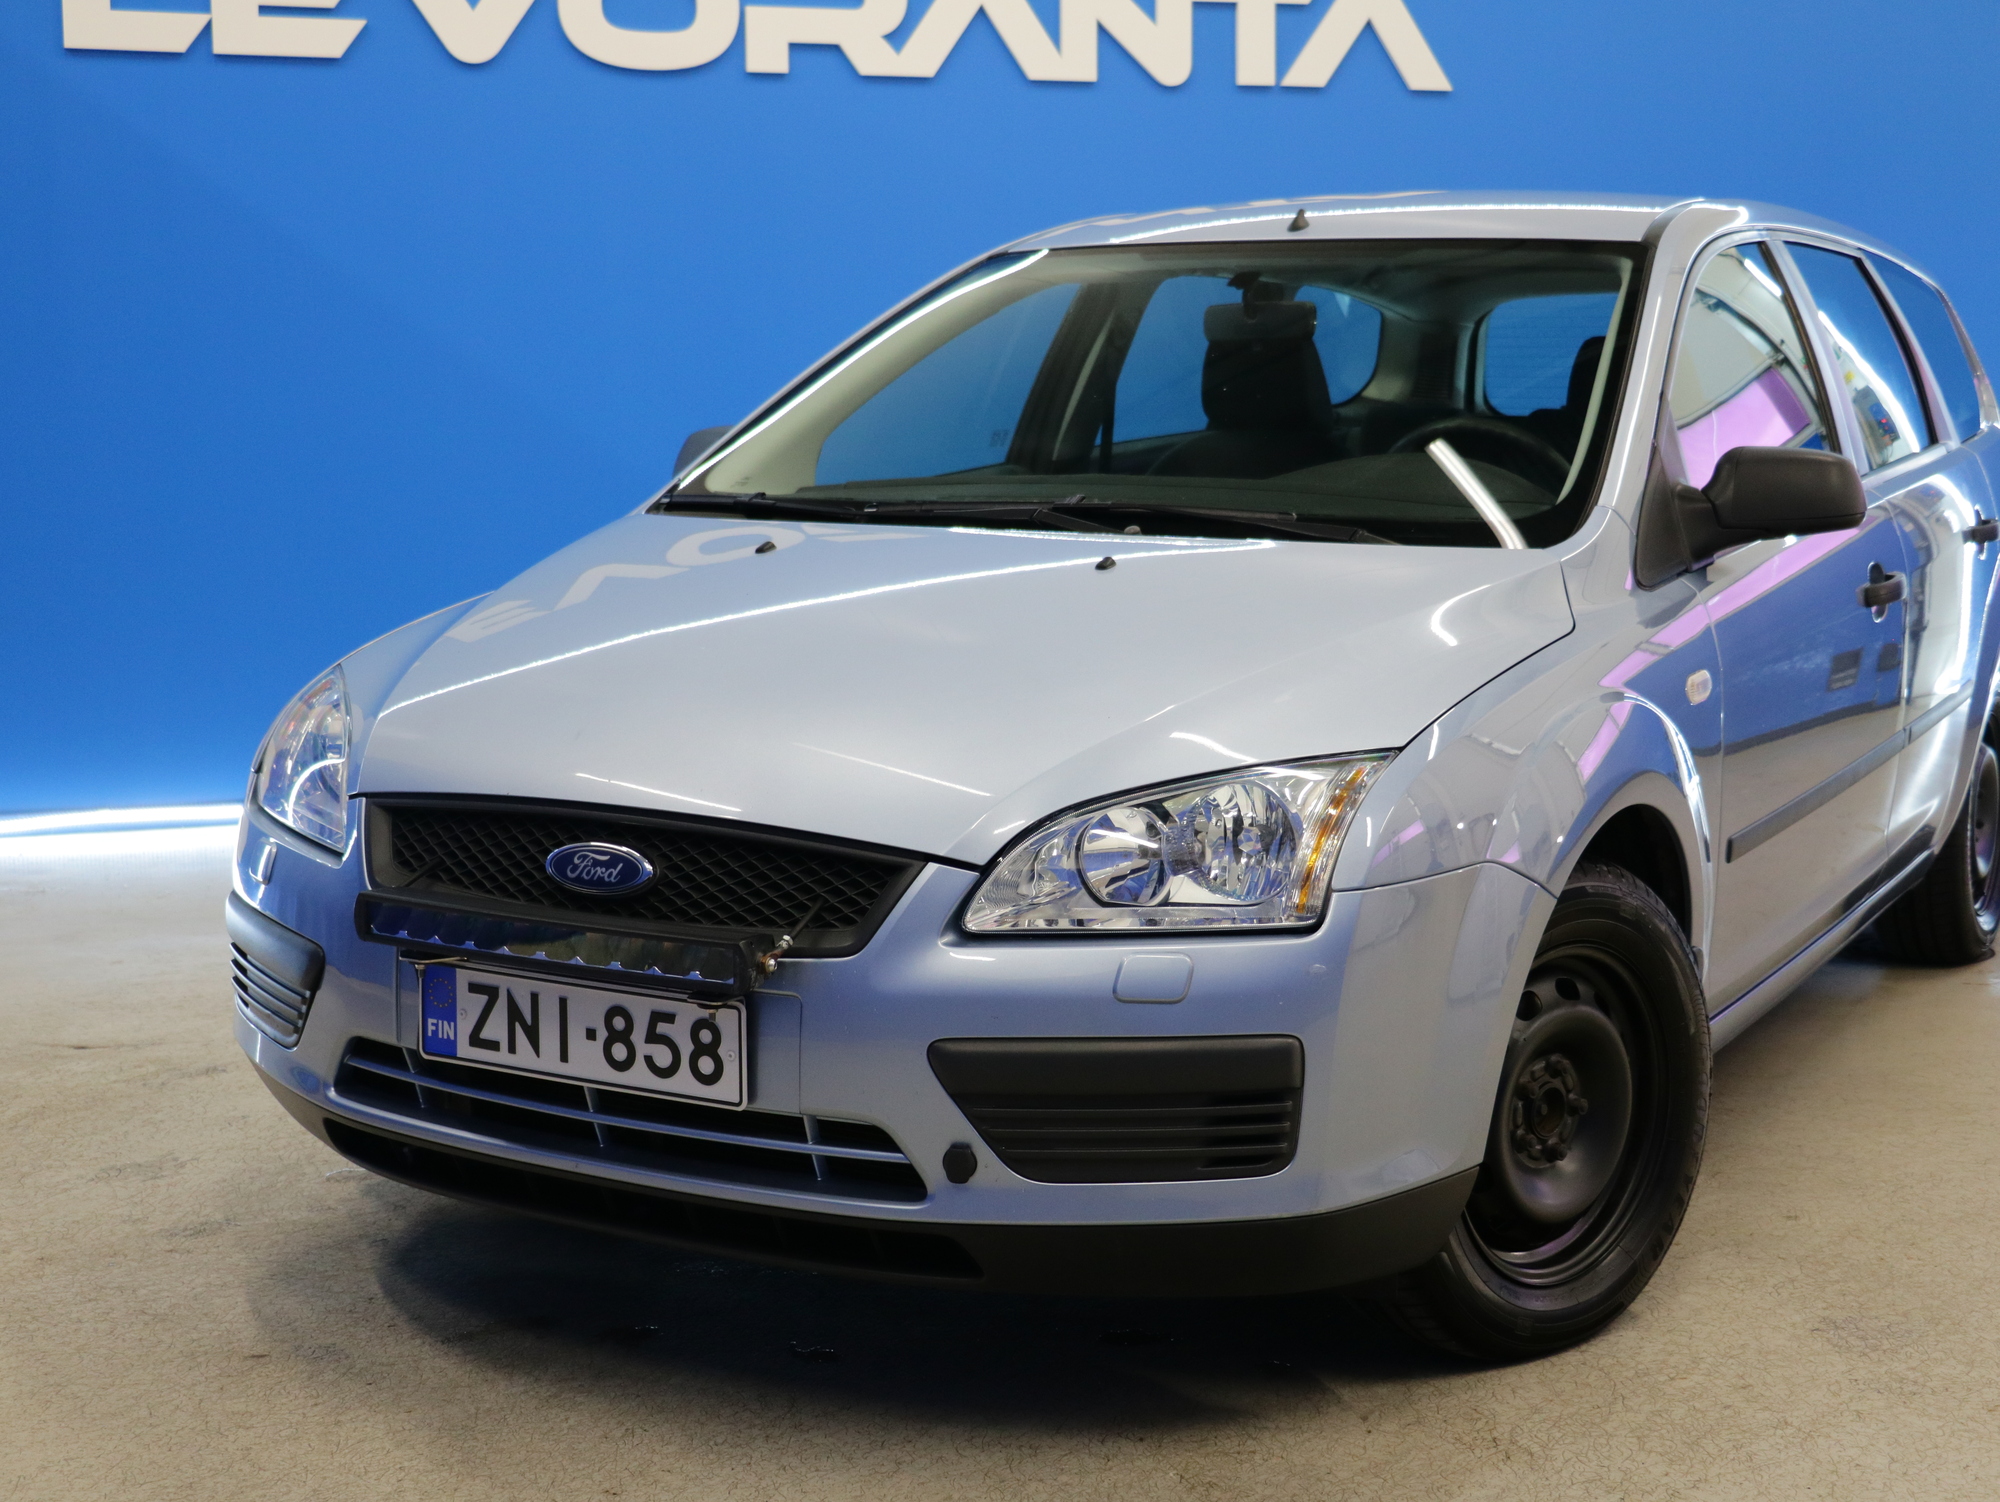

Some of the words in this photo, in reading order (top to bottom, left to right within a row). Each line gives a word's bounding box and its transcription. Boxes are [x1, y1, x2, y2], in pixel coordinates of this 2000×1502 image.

[567, 851, 623, 882] Ford
[427, 1018, 455, 1041] FIN
[467, 982, 724, 1086] ZNI-858
